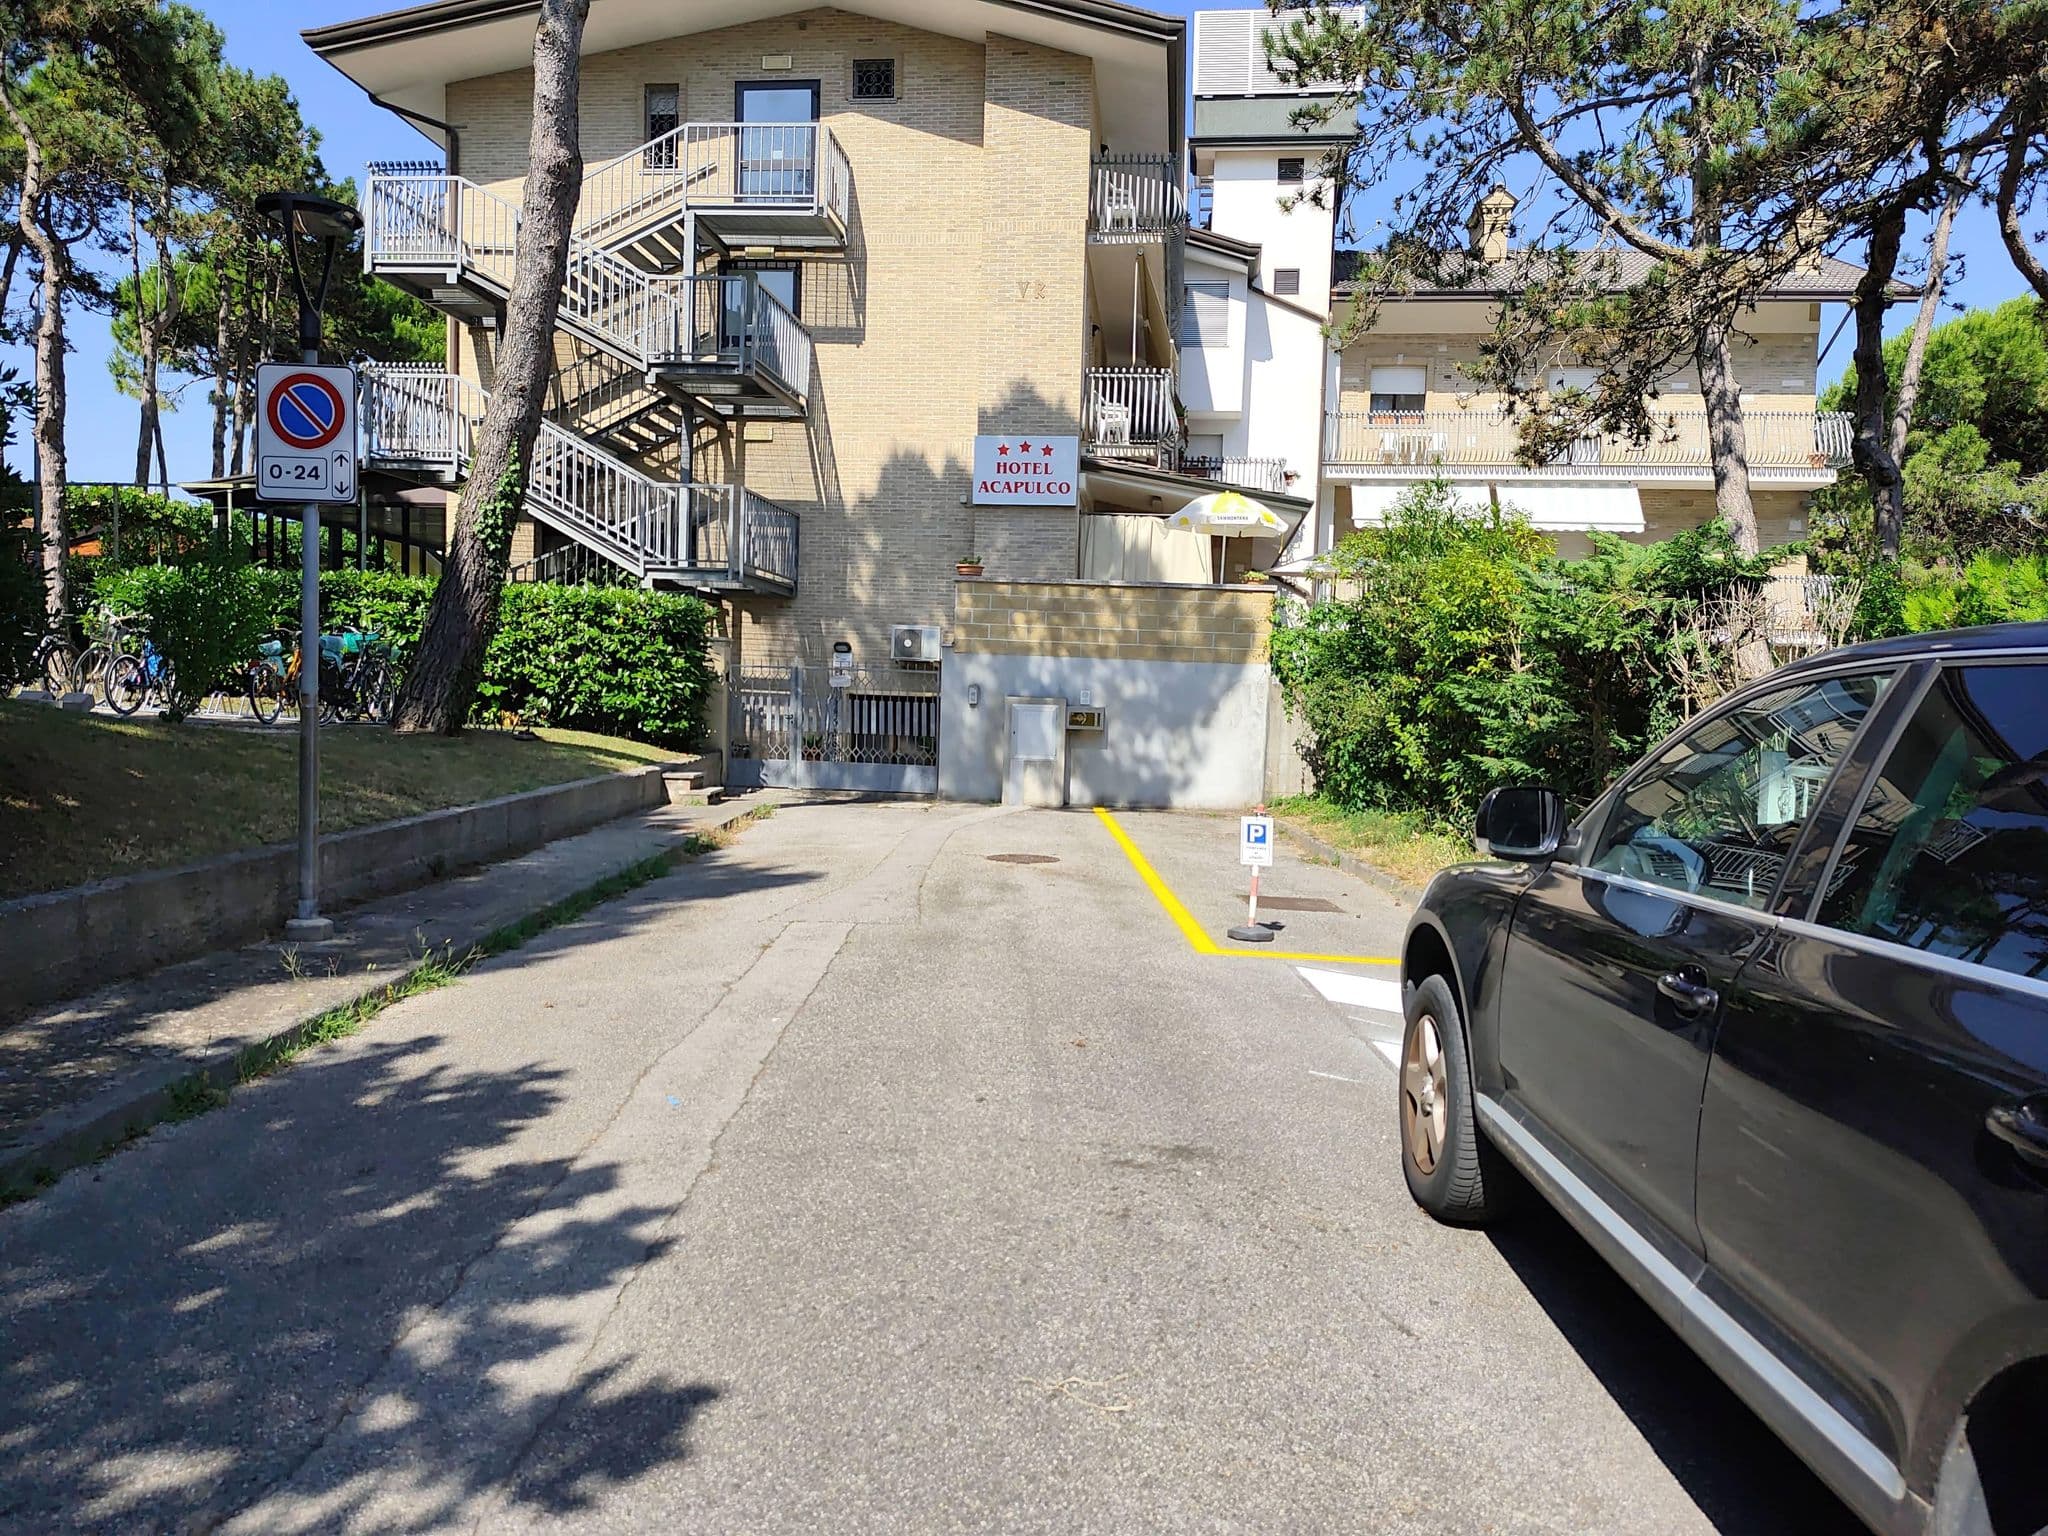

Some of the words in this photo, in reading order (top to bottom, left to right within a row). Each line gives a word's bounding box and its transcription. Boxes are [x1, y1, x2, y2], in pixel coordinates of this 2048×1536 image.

[269, 464, 320, 480] 0-24
[996, 462, 1053, 475] HOTEL
[978, 481, 1071, 494] ACAPULCO
[1249, 824, 1265, 842] P
